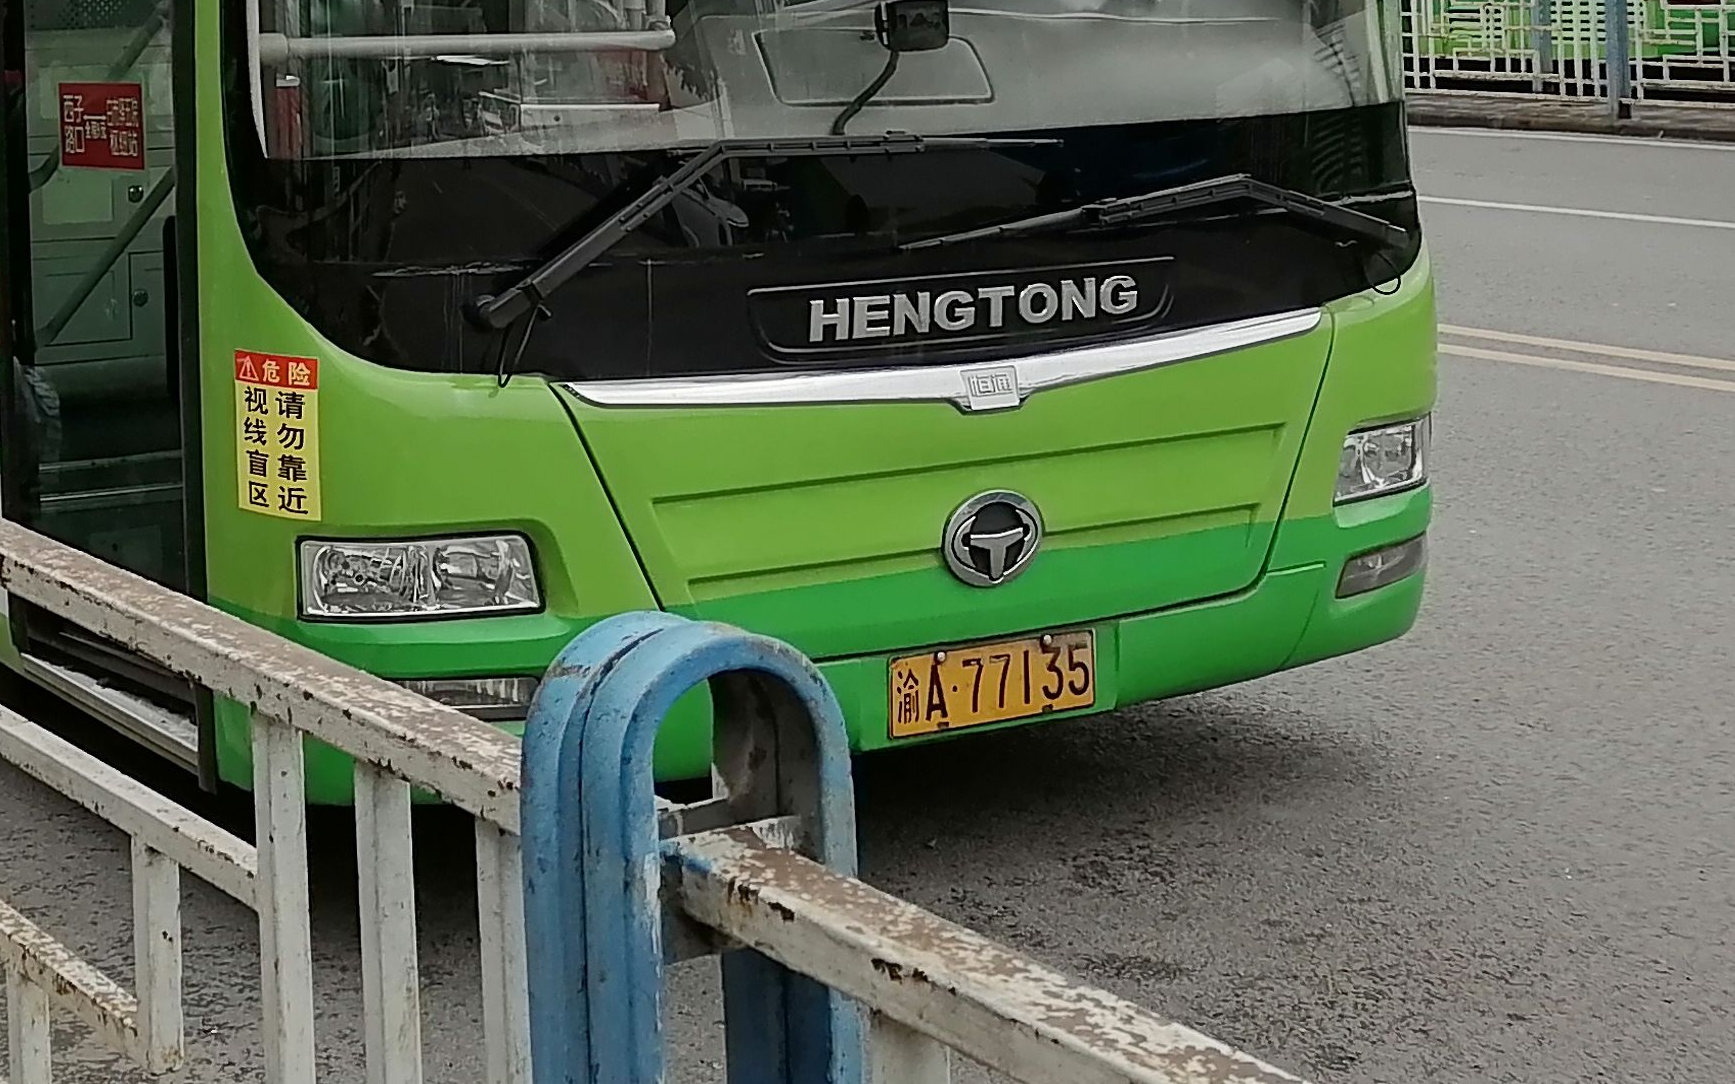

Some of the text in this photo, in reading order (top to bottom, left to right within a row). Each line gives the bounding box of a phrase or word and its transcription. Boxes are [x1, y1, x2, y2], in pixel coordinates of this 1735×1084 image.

[809, 275, 1137, 342] HENGTONG
[261, 359, 311, 386] 危险
[244, 386, 269, 508] 视线盲区
[275, 391, 308, 515] 请勿靠近
